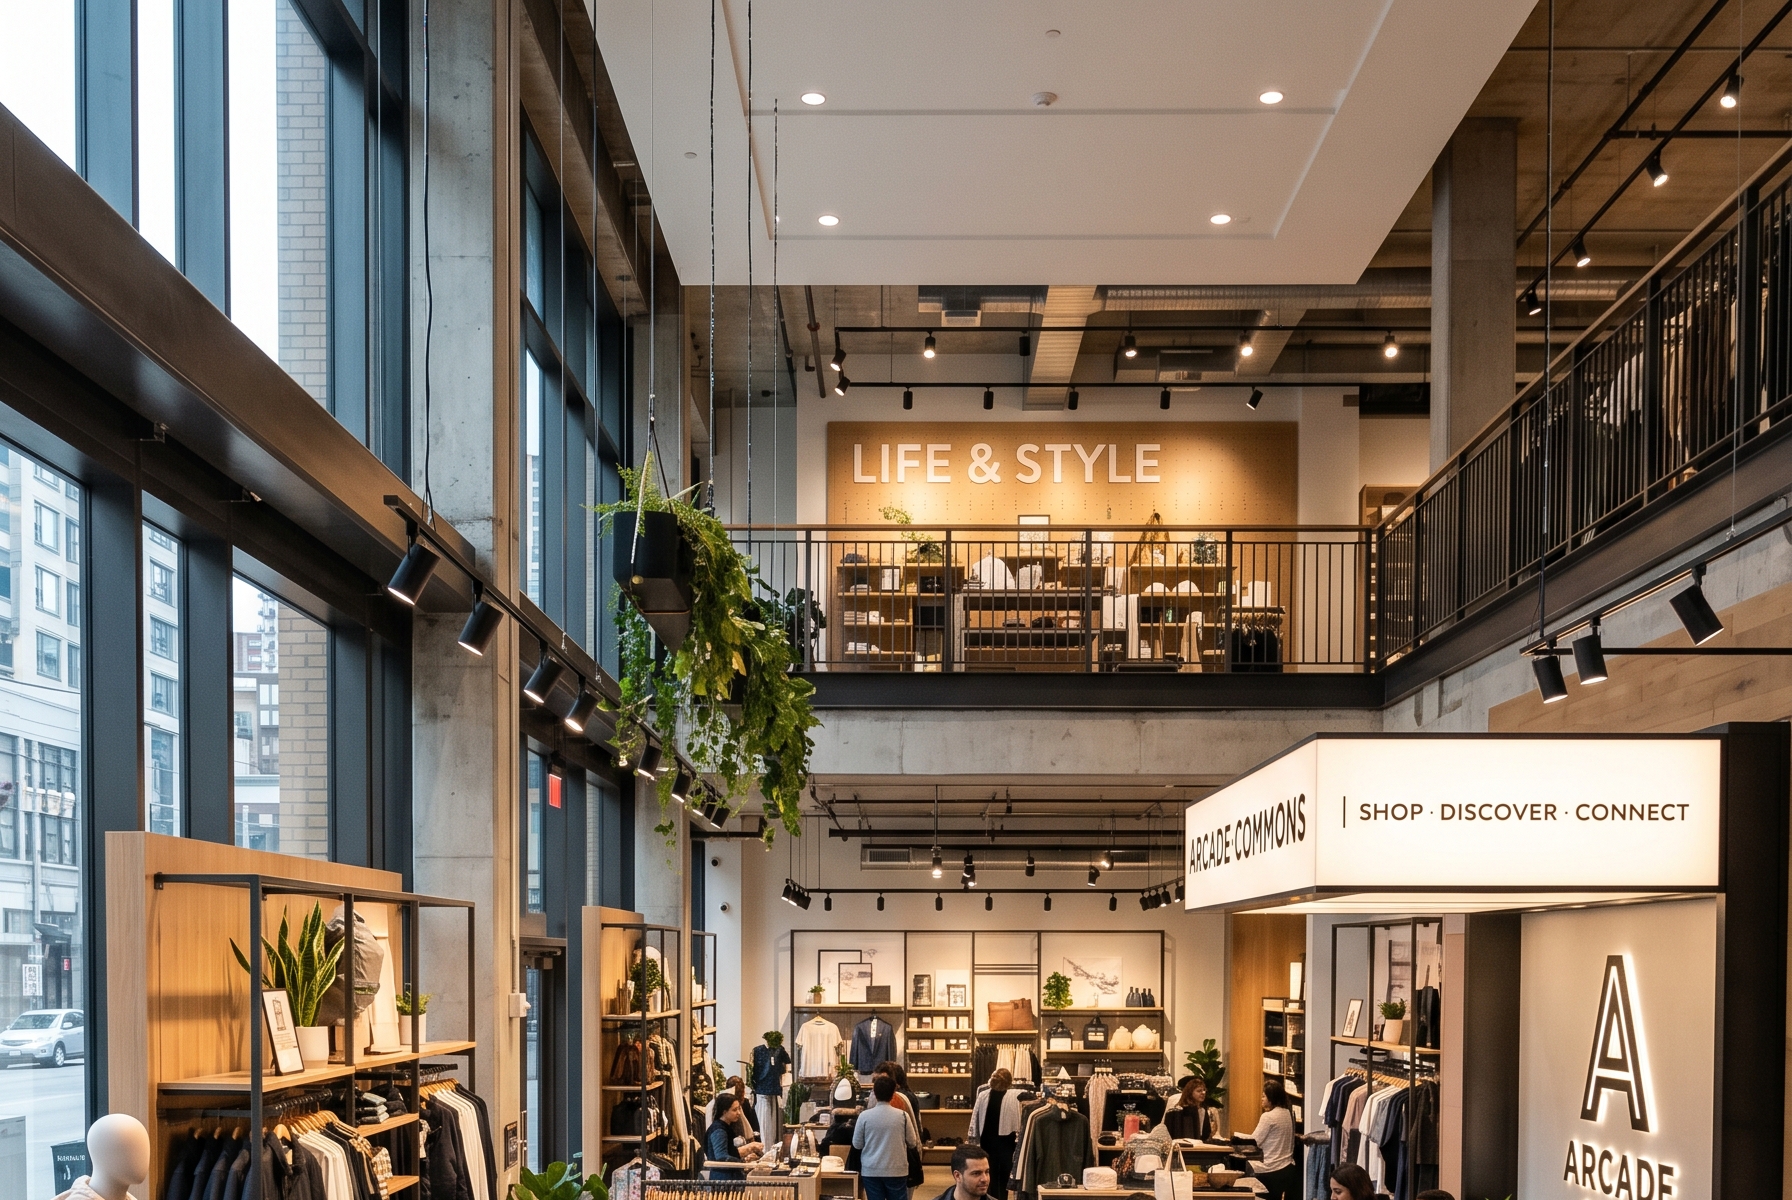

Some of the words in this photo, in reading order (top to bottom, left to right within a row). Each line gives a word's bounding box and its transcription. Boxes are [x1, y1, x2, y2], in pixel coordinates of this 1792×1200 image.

[853, 443, 951, 484] LIFE
[967, 442, 1002, 484] &
[1015, 443, 1161, 484] STYLE
[1359, 803, 1423, 821] SHOP
[1440, 803, 1557, 821] DISCOVER
[1575, 803, 1690, 821] CONNECT
[1580, 955, 1650, 1133] A
